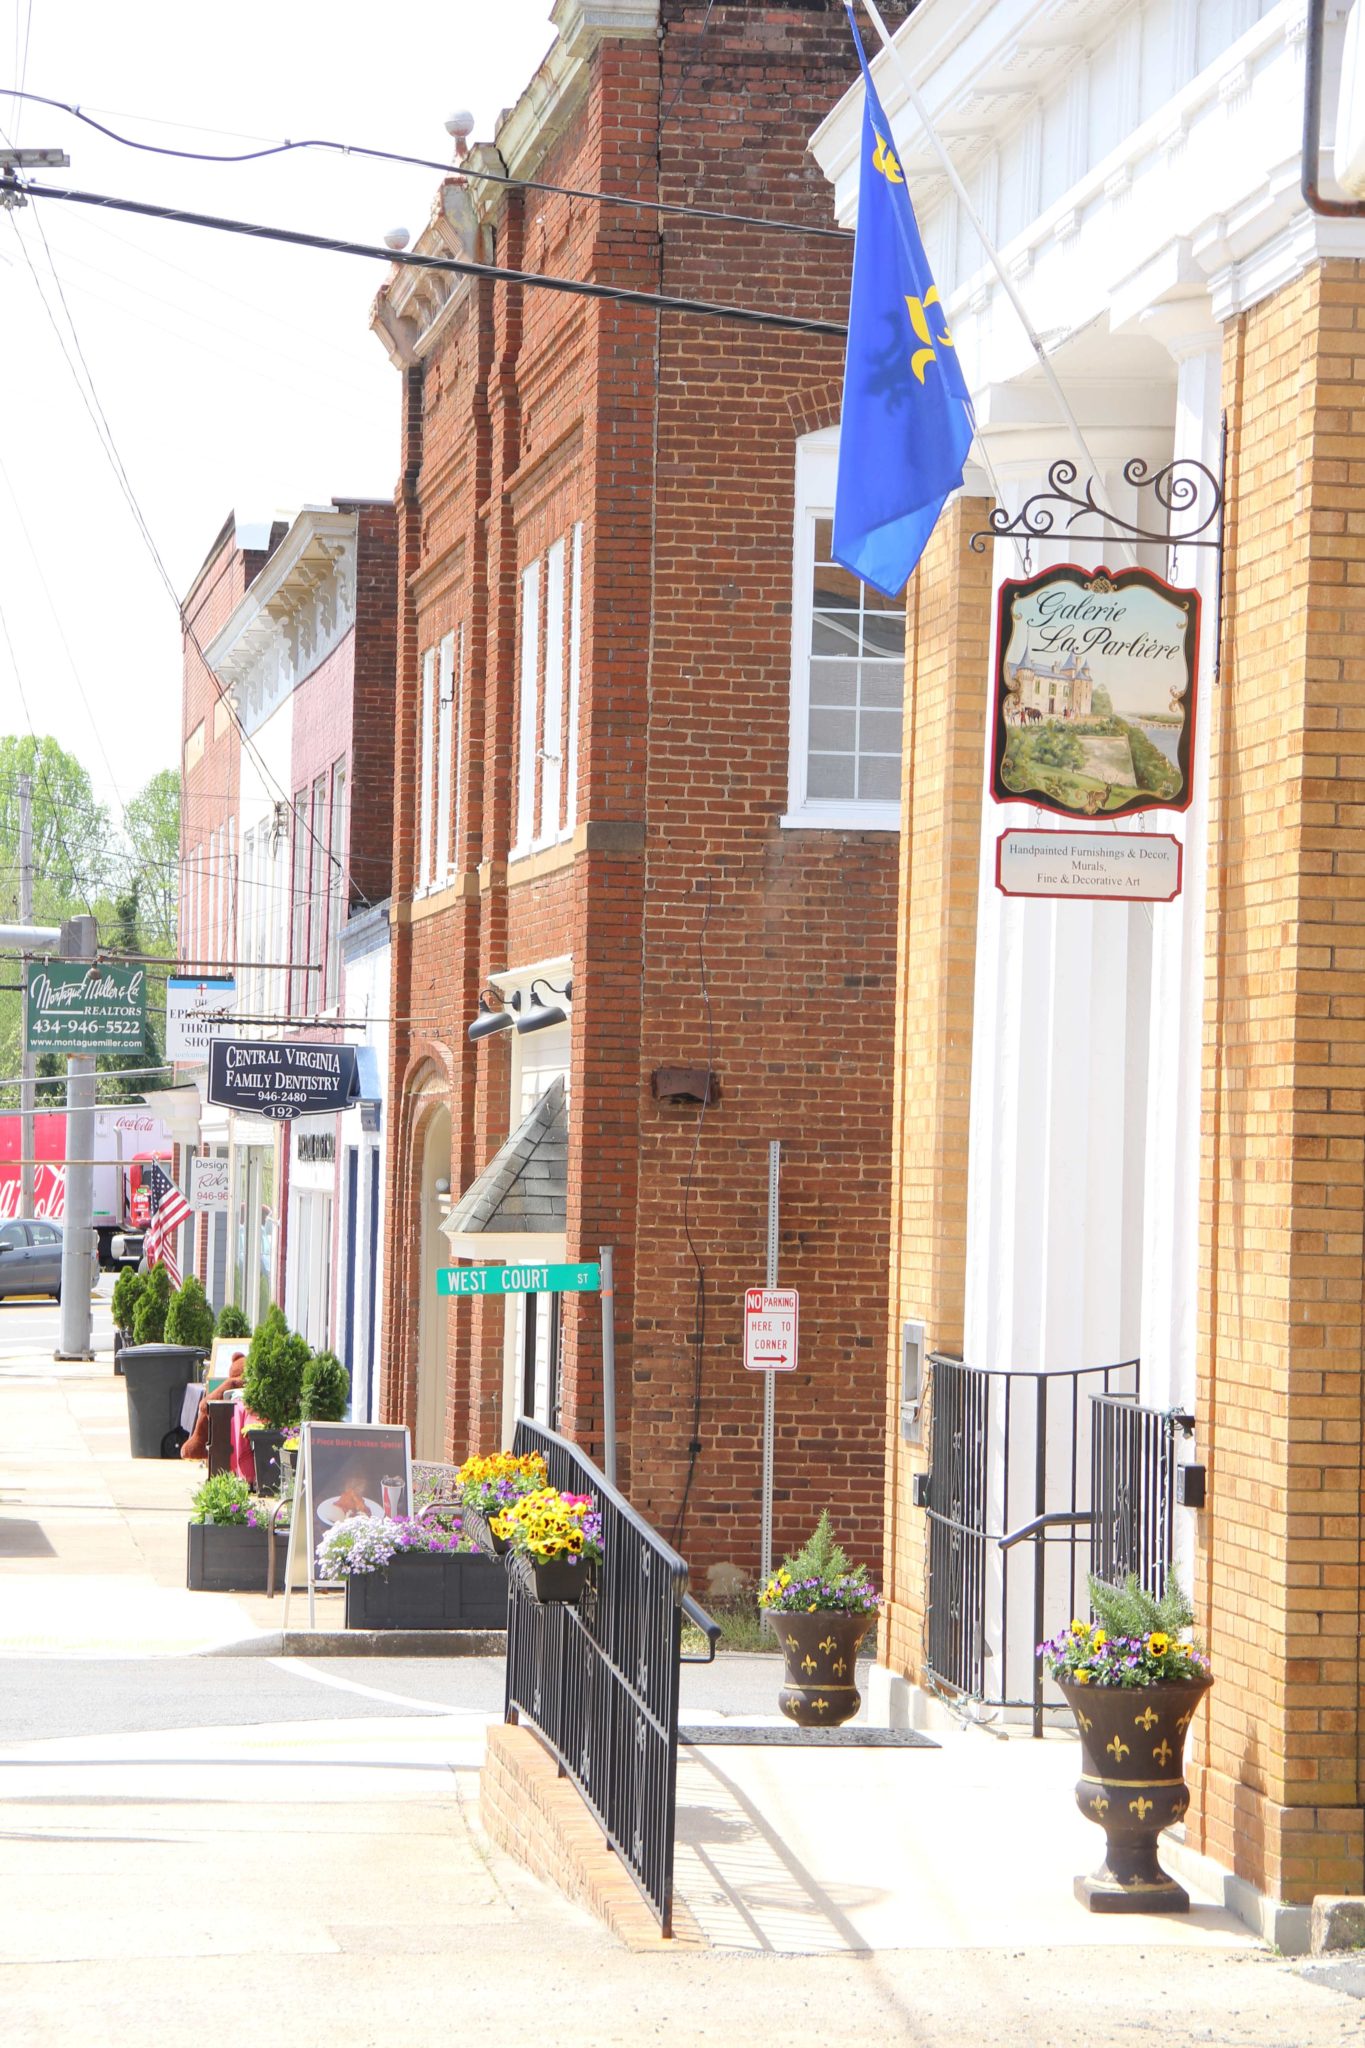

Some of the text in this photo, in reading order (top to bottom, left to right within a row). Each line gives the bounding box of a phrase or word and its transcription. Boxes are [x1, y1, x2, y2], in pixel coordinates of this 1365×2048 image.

[1027, 591, 1127, 627] Galerie
[1032, 624, 1075, 654] La
[1009, 844, 1170, 861] Handpainted Furnishings & Decor,
[1071, 860, 1107, 872] Murals,
[1037, 873, 1141, 887] Fine & Decorative Art
[84, 1006, 142, 1016] REALTORS
[32, 1019, 141, 1034] 434-946-5522
[180, 1023, 221, 1034] THRIFT
[30, 1038, 143, 1048] www.montaguemiller.com
[184, 1037, 210, 1048] SHO
[226, 1046, 341, 1074] CENTRAL VIRGINIA
[225, 1070, 341, 1091] FAMILY DENTISTRY
[258, 1092, 307, 1103] 946-2480
[270, 1107, 293, 1118] 192
[448, 1268, 588, 1292] WEST COURT ST
[748, 1293, 794, 1309] NO PARKING
[751, 1320, 791, 1332] HERE TO
[755, 1339, 788, 1350] CORNER
